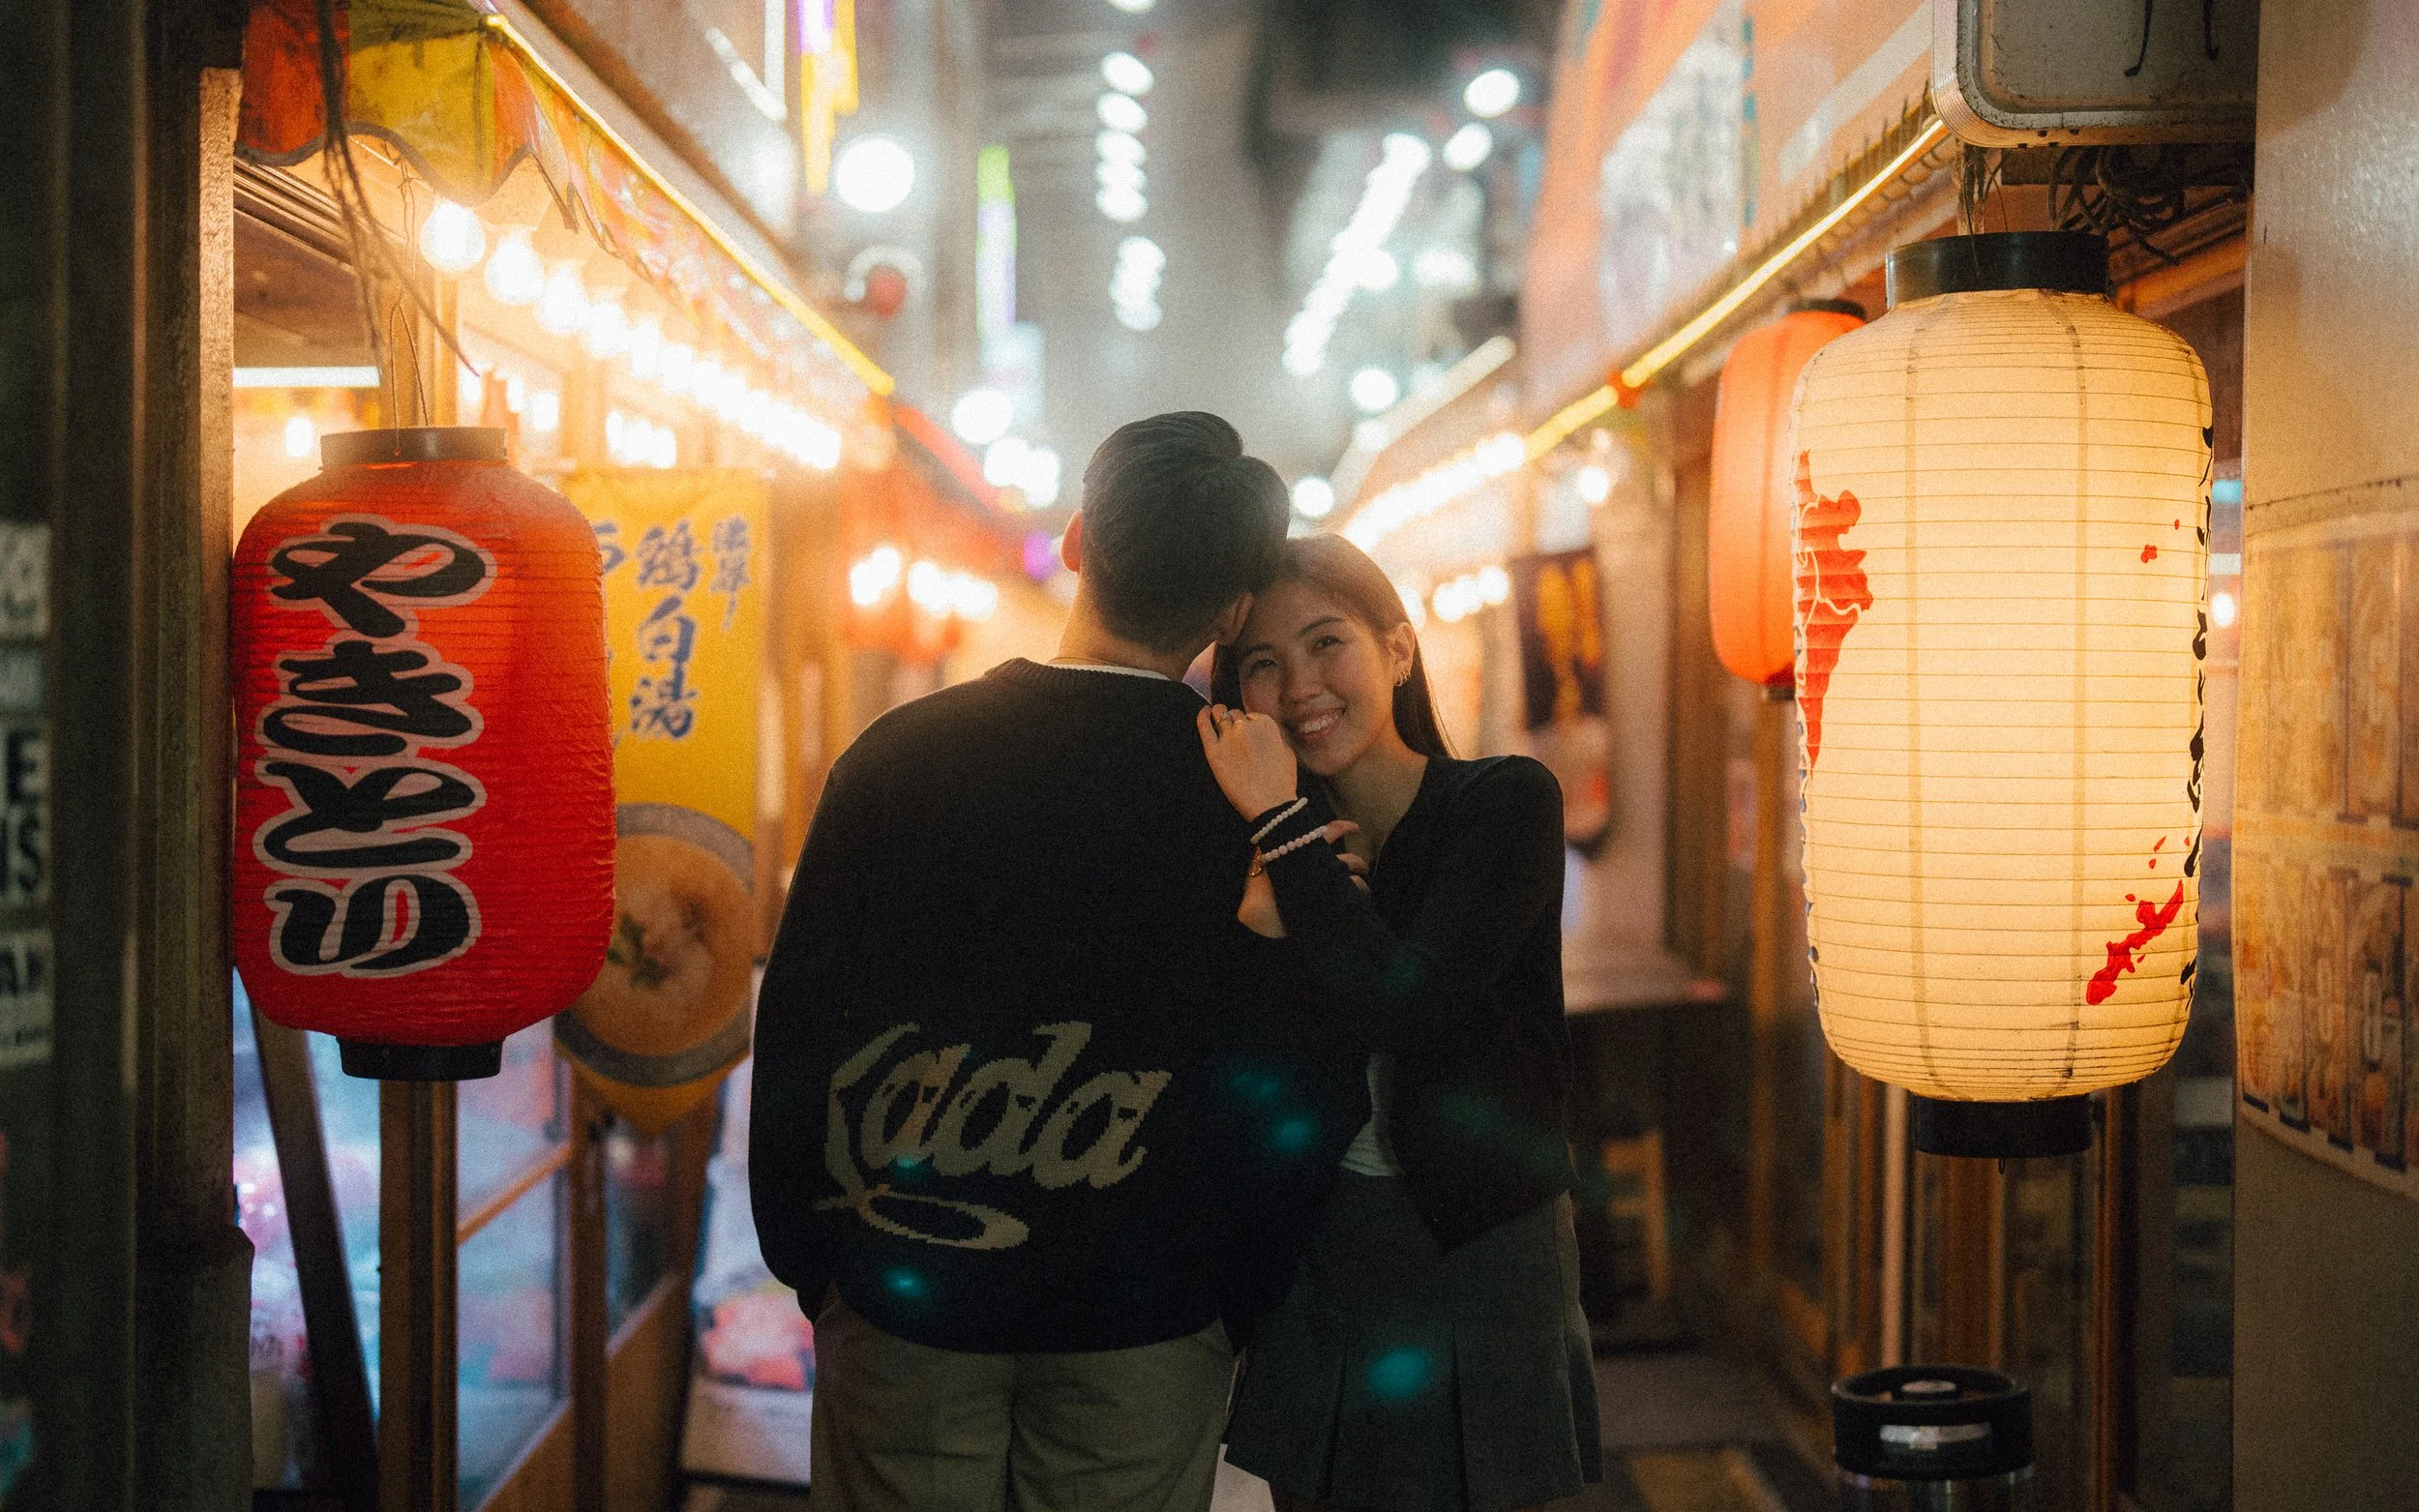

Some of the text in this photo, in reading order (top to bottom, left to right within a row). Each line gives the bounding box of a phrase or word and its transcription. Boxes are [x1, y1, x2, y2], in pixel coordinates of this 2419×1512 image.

[255, 515, 495, 977] やきとり
[631, 519, 701, 740] 鶏白湯
